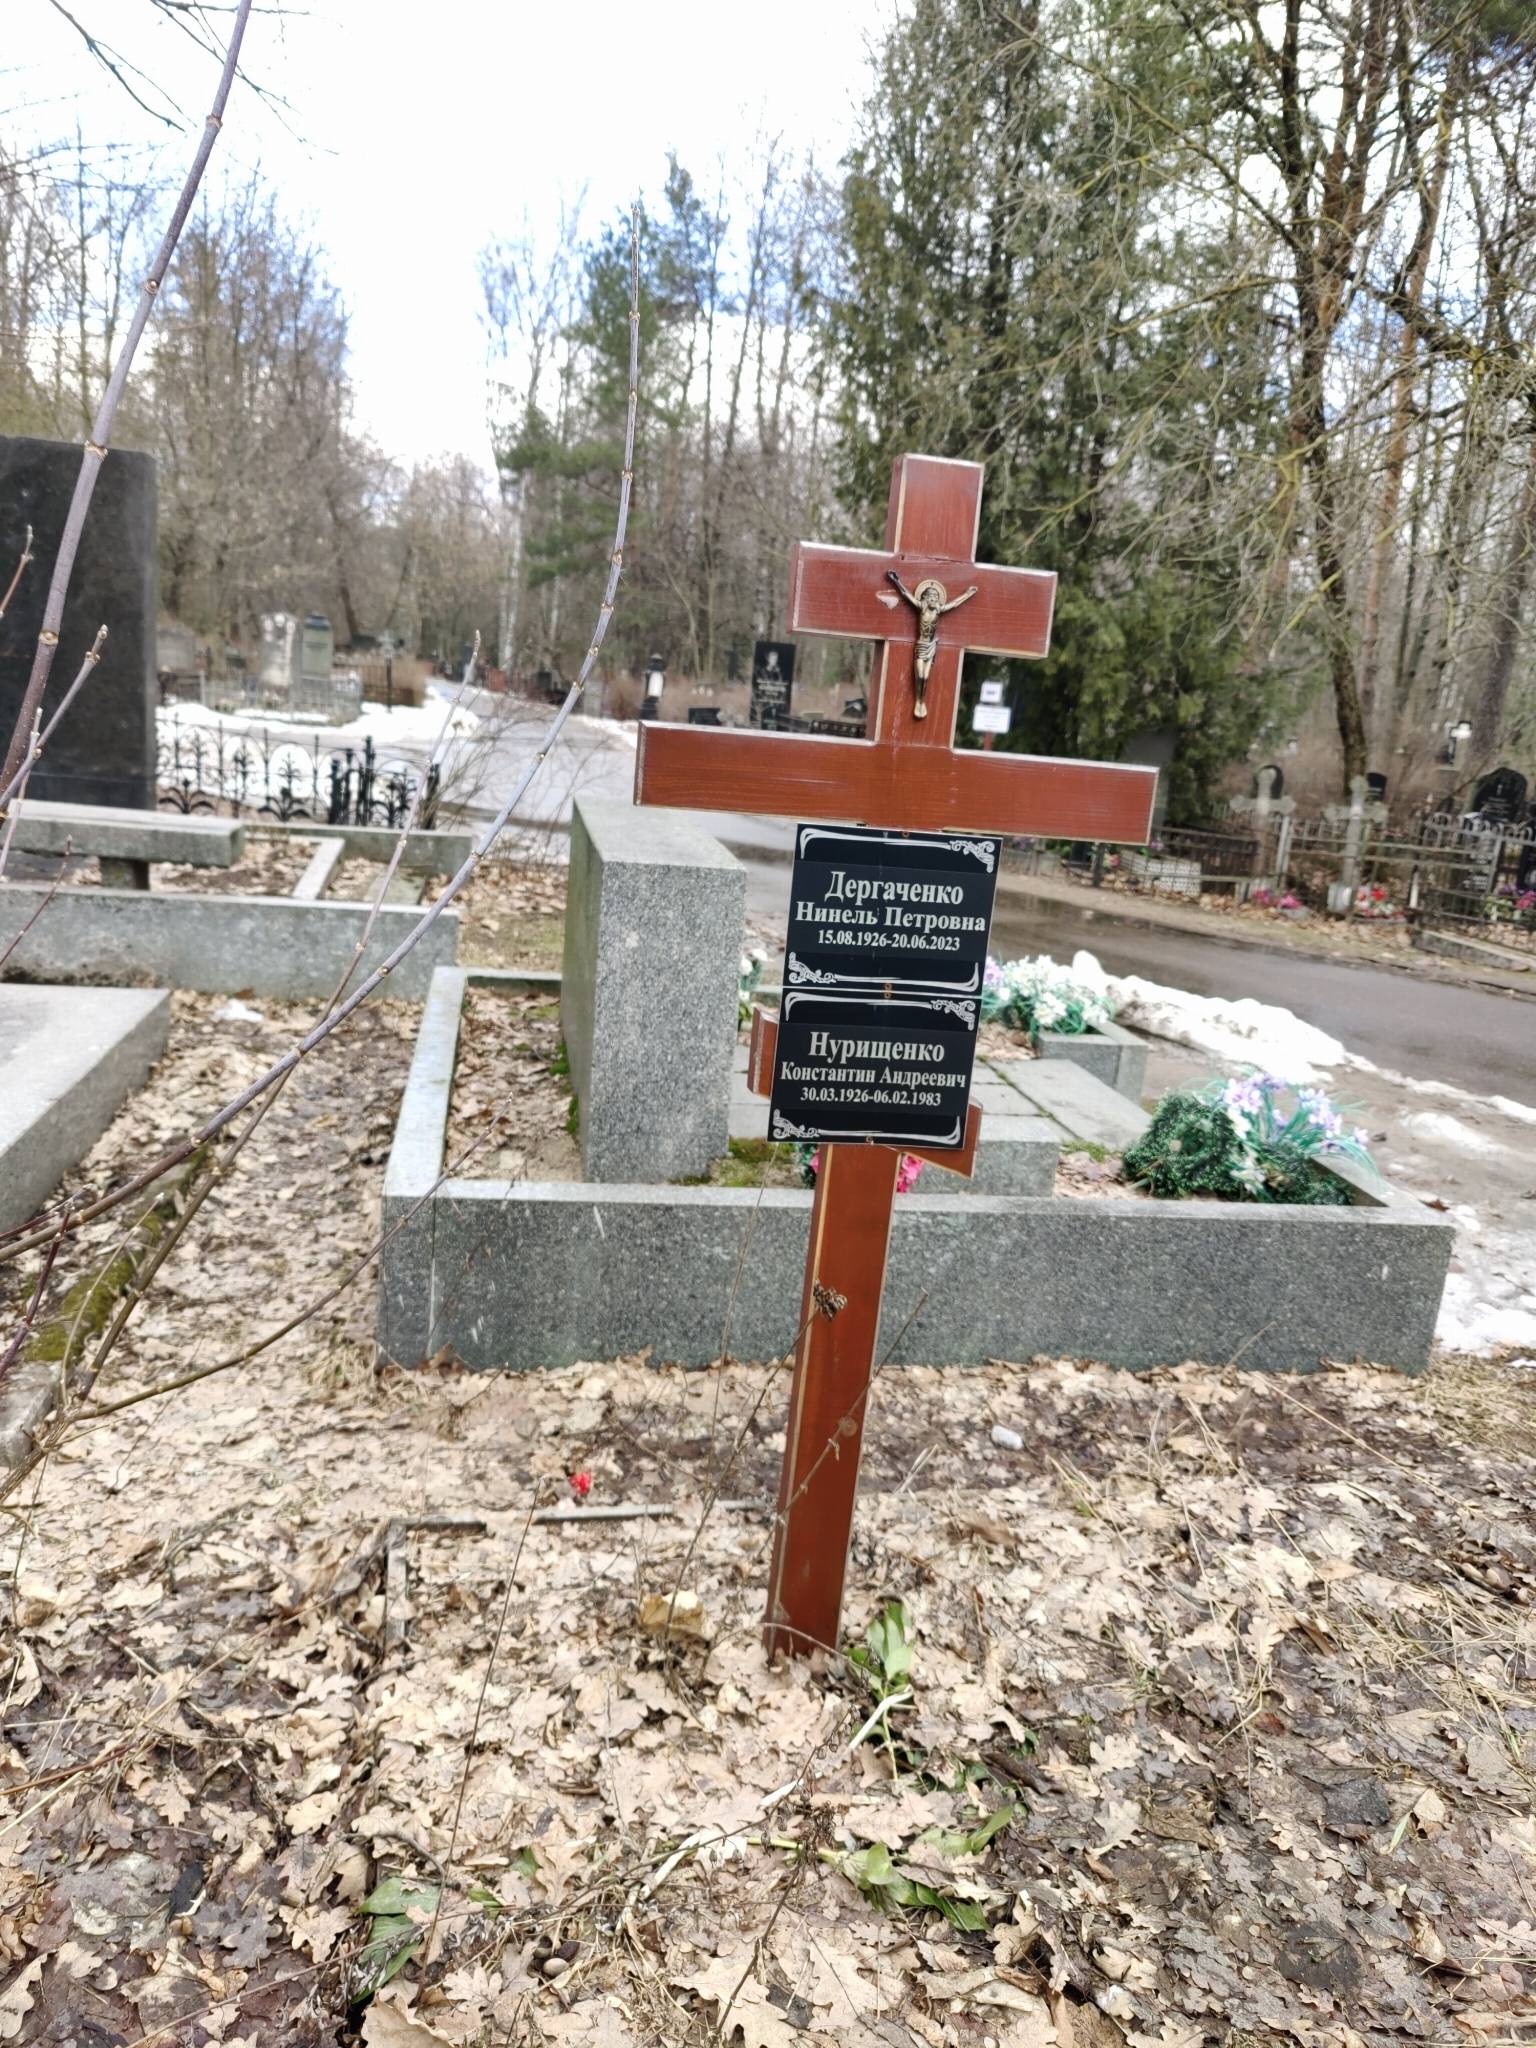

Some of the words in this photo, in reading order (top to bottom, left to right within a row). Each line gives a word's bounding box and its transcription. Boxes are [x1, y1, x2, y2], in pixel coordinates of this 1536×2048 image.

[825, 871, 964, 905] Дергаченко
[796, 902, 877, 925] Нинель
[885, 907, 985, 932] Петровна
[818, 930, 960, 950] 15.08.1926-20.06.2023
[808, 1031, 945, 1063] Нурищенко
[781, 1062, 875, 1083] Константин
[880, 1068, 966, 1089] Андреевич
[800, 1087, 941, 1106] 30.03.1926-06.02.1983
